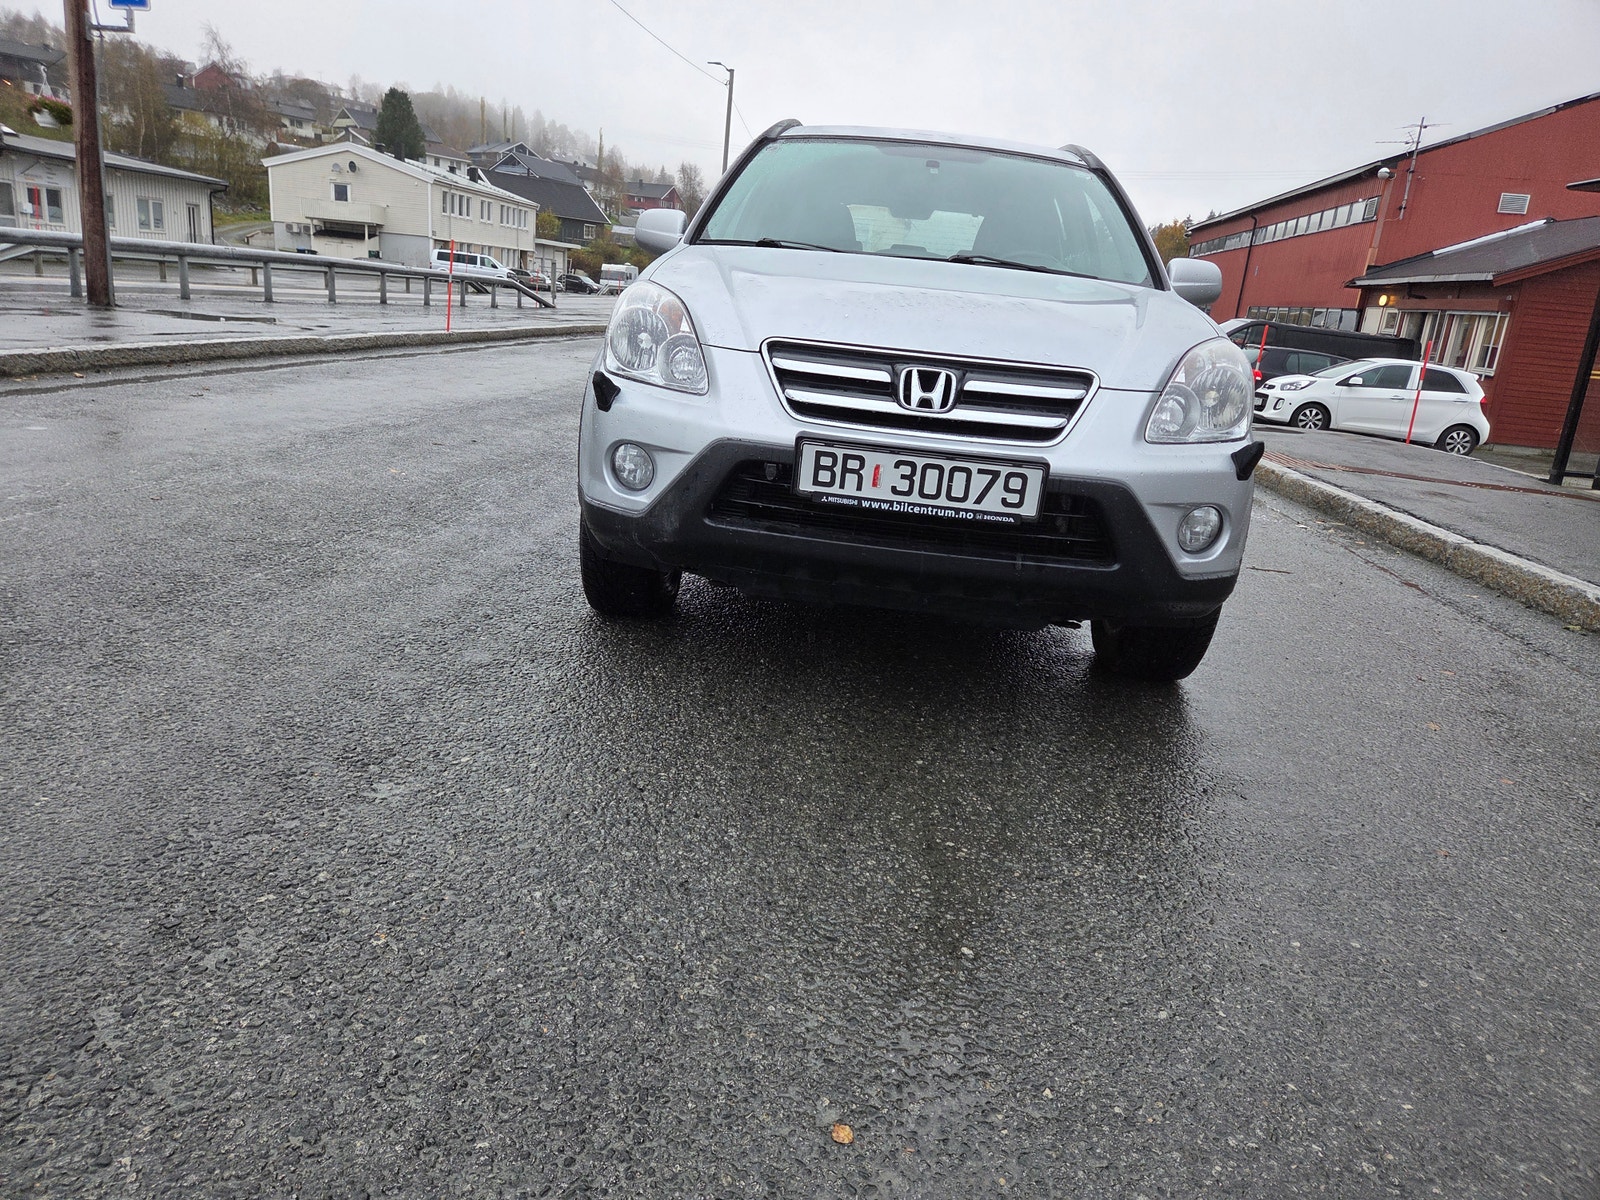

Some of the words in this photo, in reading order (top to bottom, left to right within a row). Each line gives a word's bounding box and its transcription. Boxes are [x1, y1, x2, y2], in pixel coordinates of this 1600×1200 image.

[812, 449, 866, 492] BR
[890, 459, 1029, 509] 30079
[828, 496, 858, 506] MITSUBISHI
[861, 500, 974, 519] www.bilcentrum.no
[984, 514, 1015, 523] HONDA
